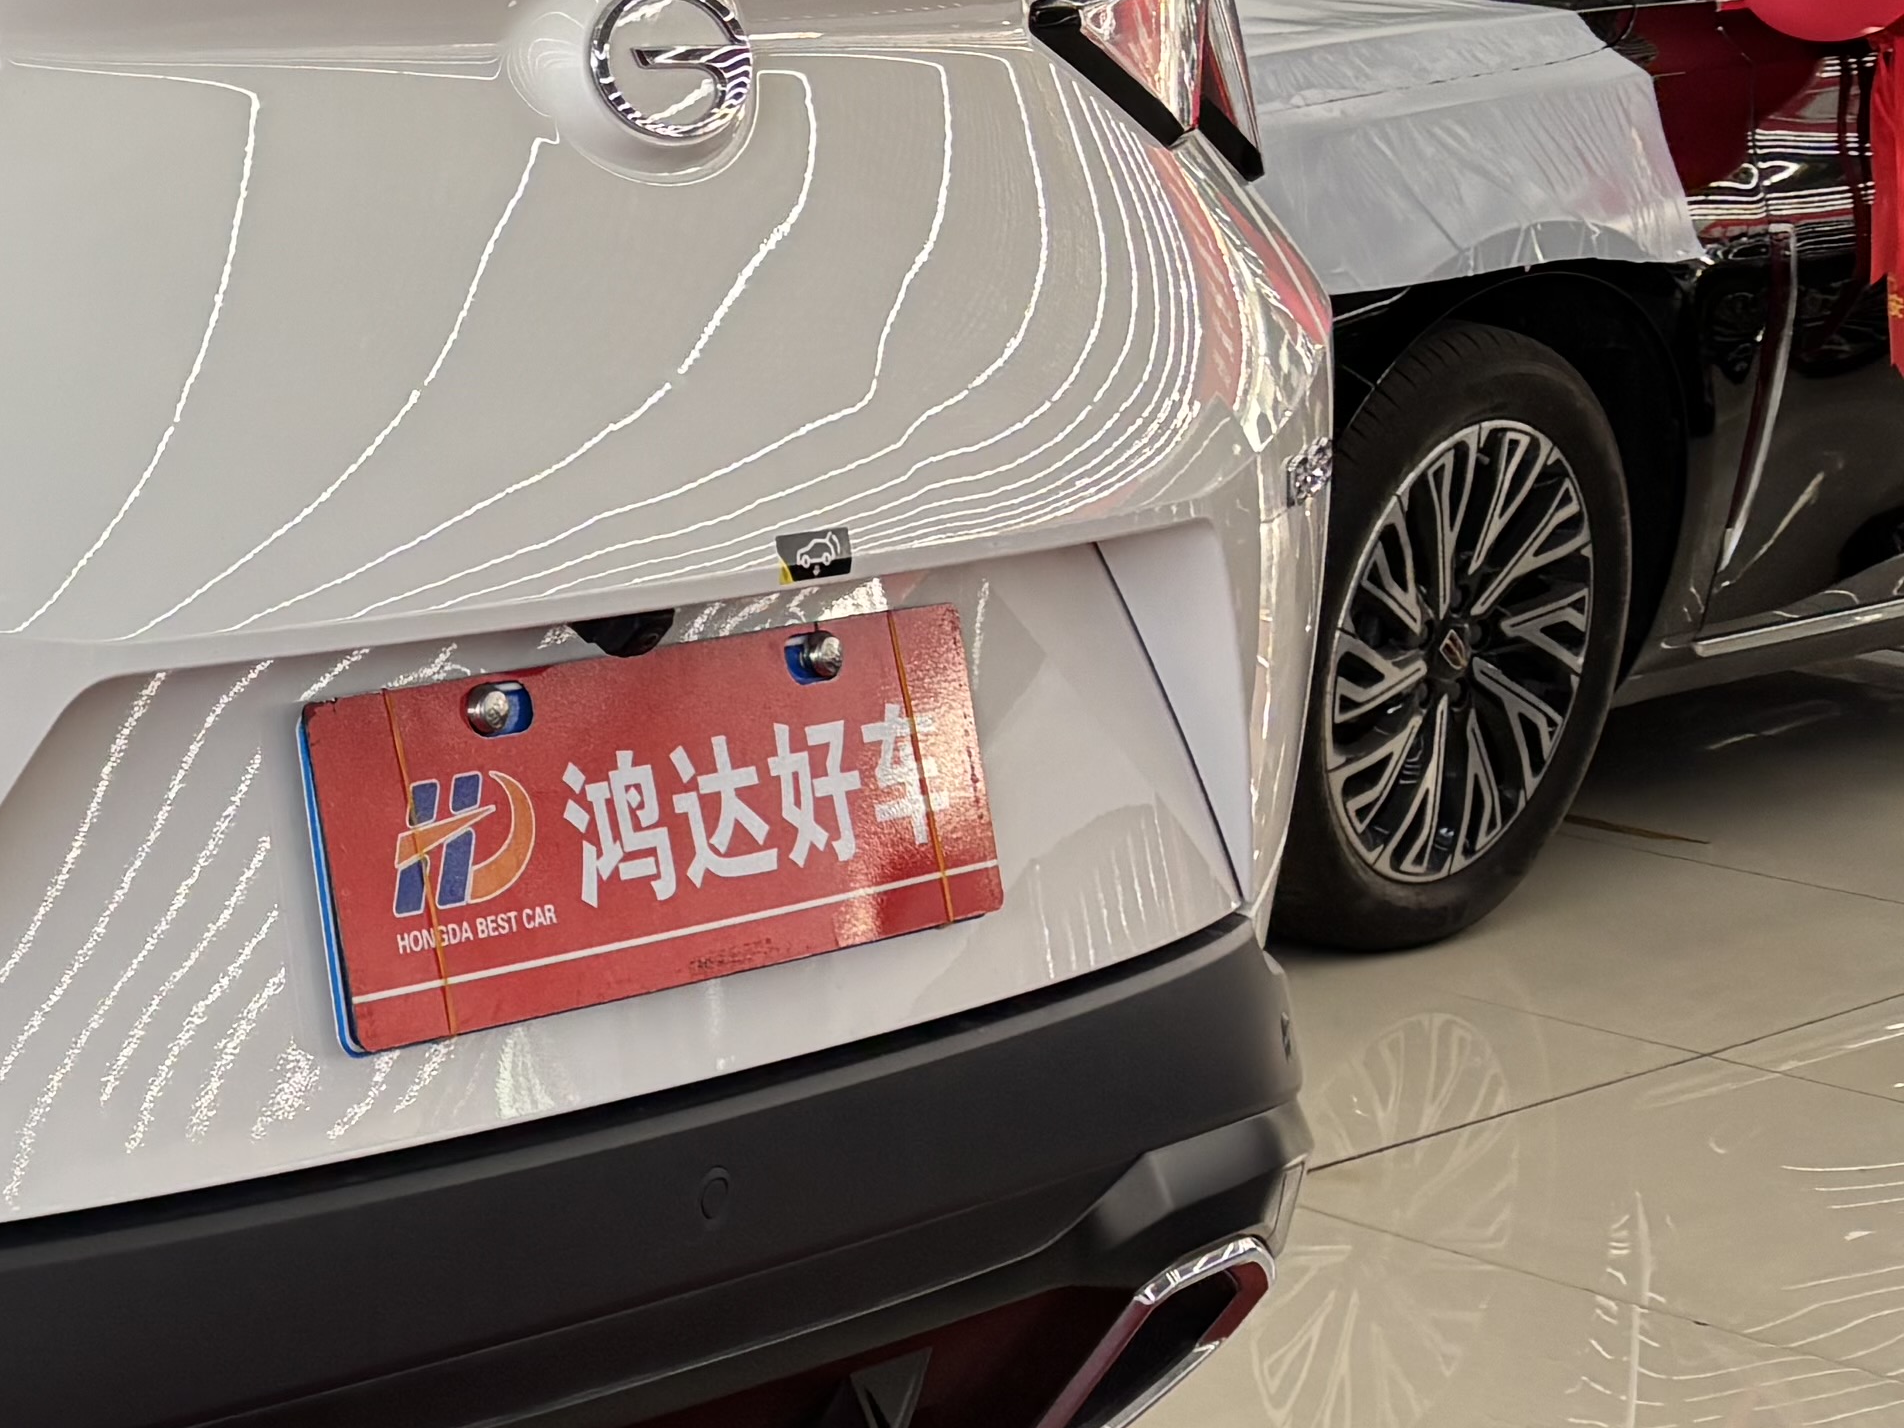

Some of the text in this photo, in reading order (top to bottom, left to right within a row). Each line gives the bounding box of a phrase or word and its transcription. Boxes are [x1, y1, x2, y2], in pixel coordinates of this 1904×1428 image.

[562, 703, 952, 909] 鸿达好车
[396, 903, 558, 955] HONGDA BEST CAR
